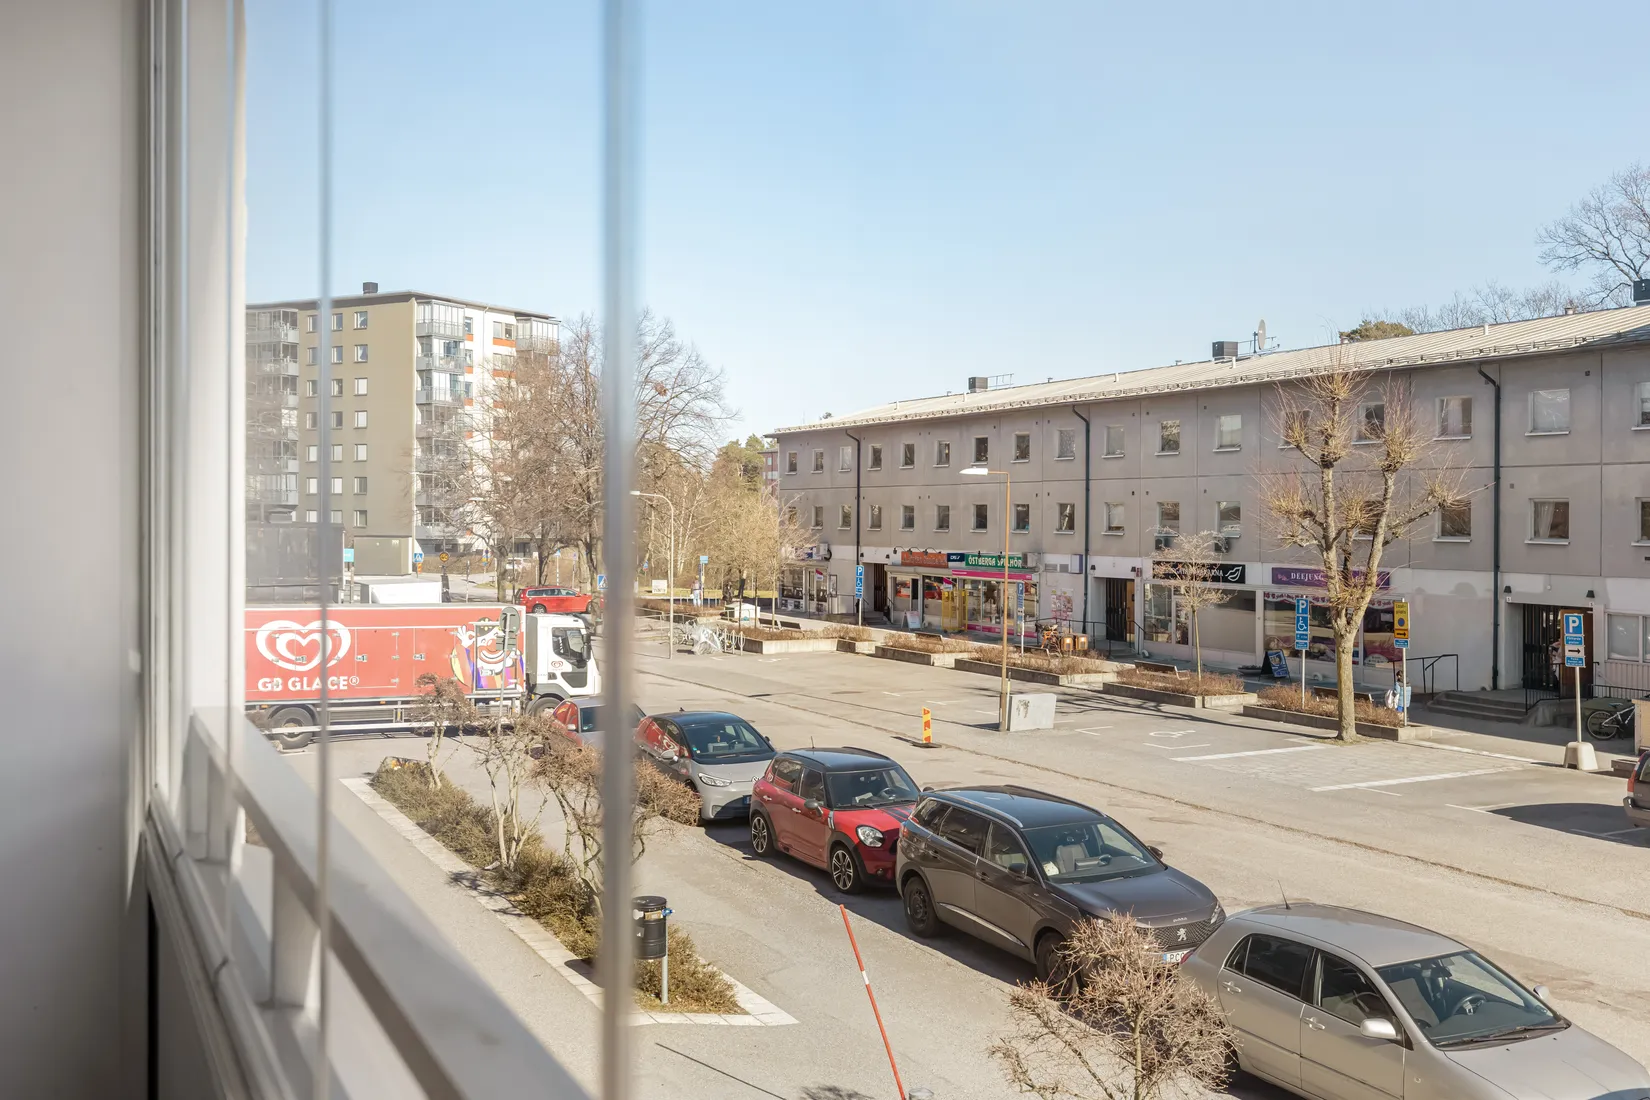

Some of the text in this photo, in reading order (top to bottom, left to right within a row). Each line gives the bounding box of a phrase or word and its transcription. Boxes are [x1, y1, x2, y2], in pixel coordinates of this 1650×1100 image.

[858, 566, 862, 576] P
[1018, 583, 1023, 594] P
[1299, 600, 1307, 614] P
[1568, 616, 1580, 633] P
[257, 677, 283, 692] GB
